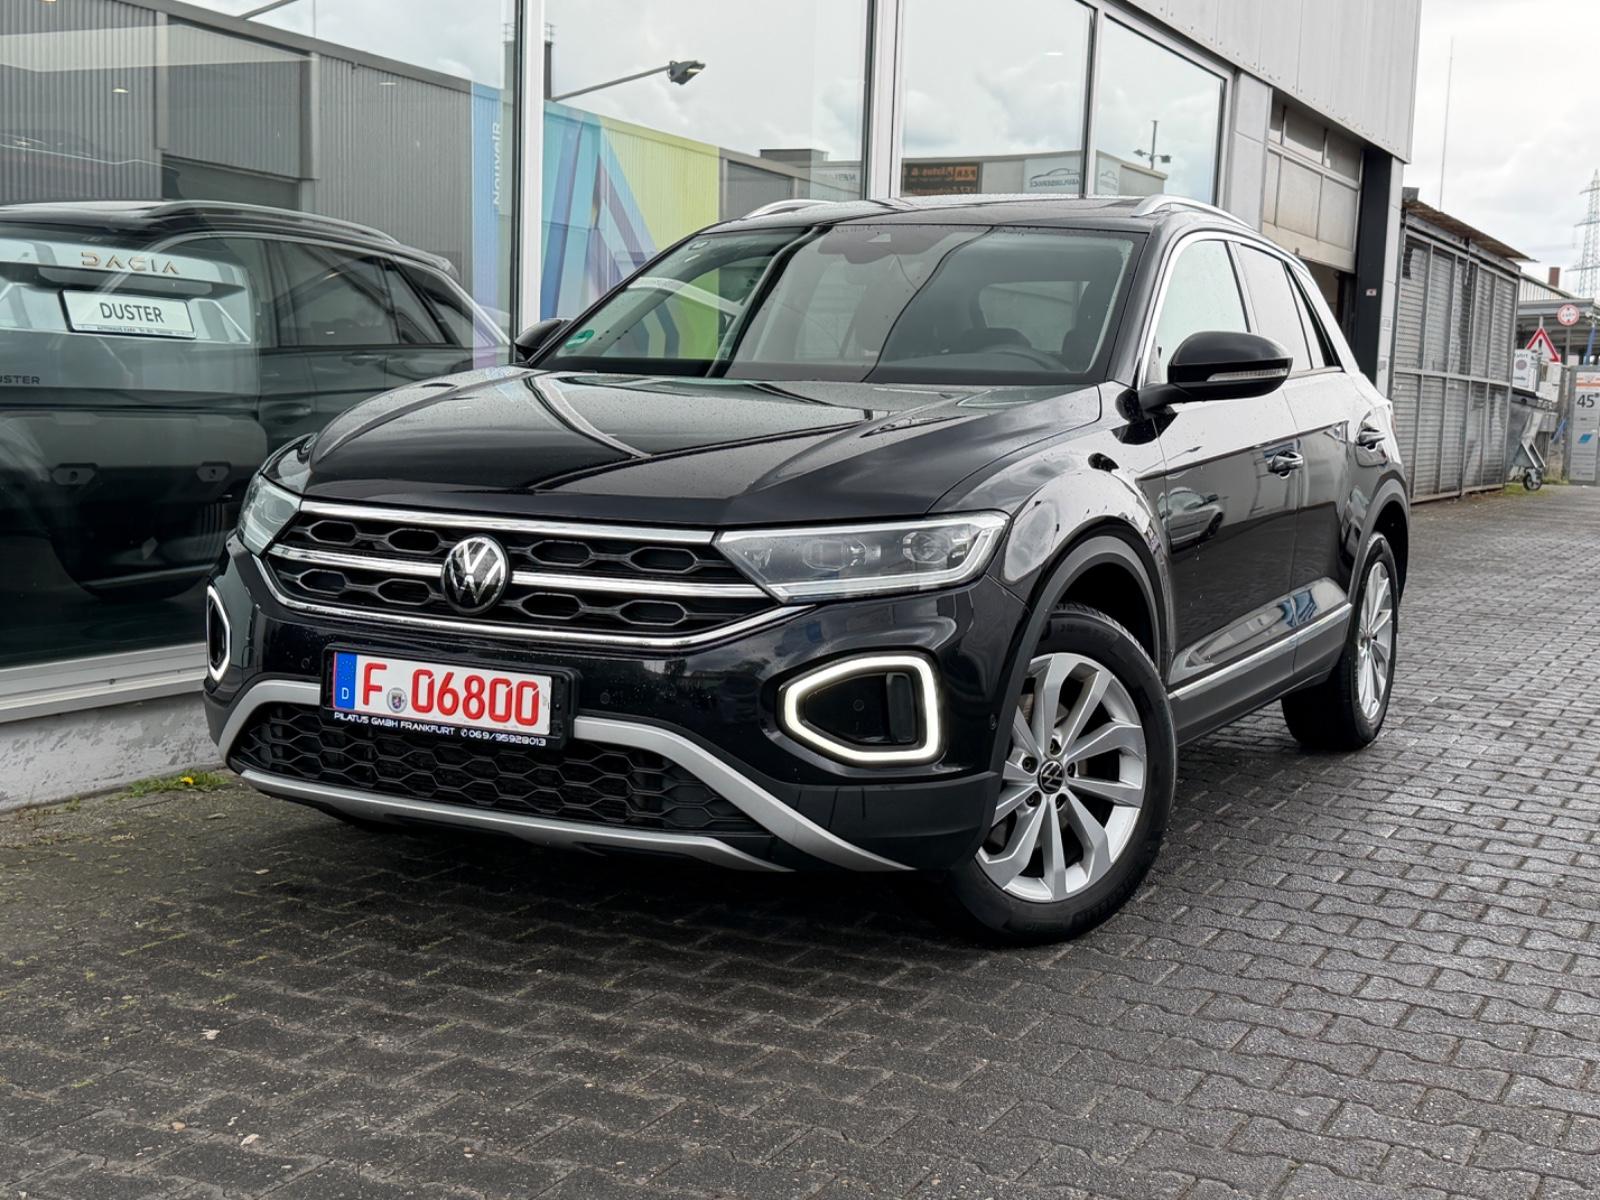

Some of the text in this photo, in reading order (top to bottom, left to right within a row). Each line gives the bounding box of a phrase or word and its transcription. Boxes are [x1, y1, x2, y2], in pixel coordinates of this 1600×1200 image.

[81, 251, 180, 275] DACIA
[99, 302, 165, 323] DUSTER
[341, 687, 349, 700] D
[362, 662, 539, 726] F 06800
[334, 712, 547, 746] PILATUS GMBH FRANKFURT 069/95928013
